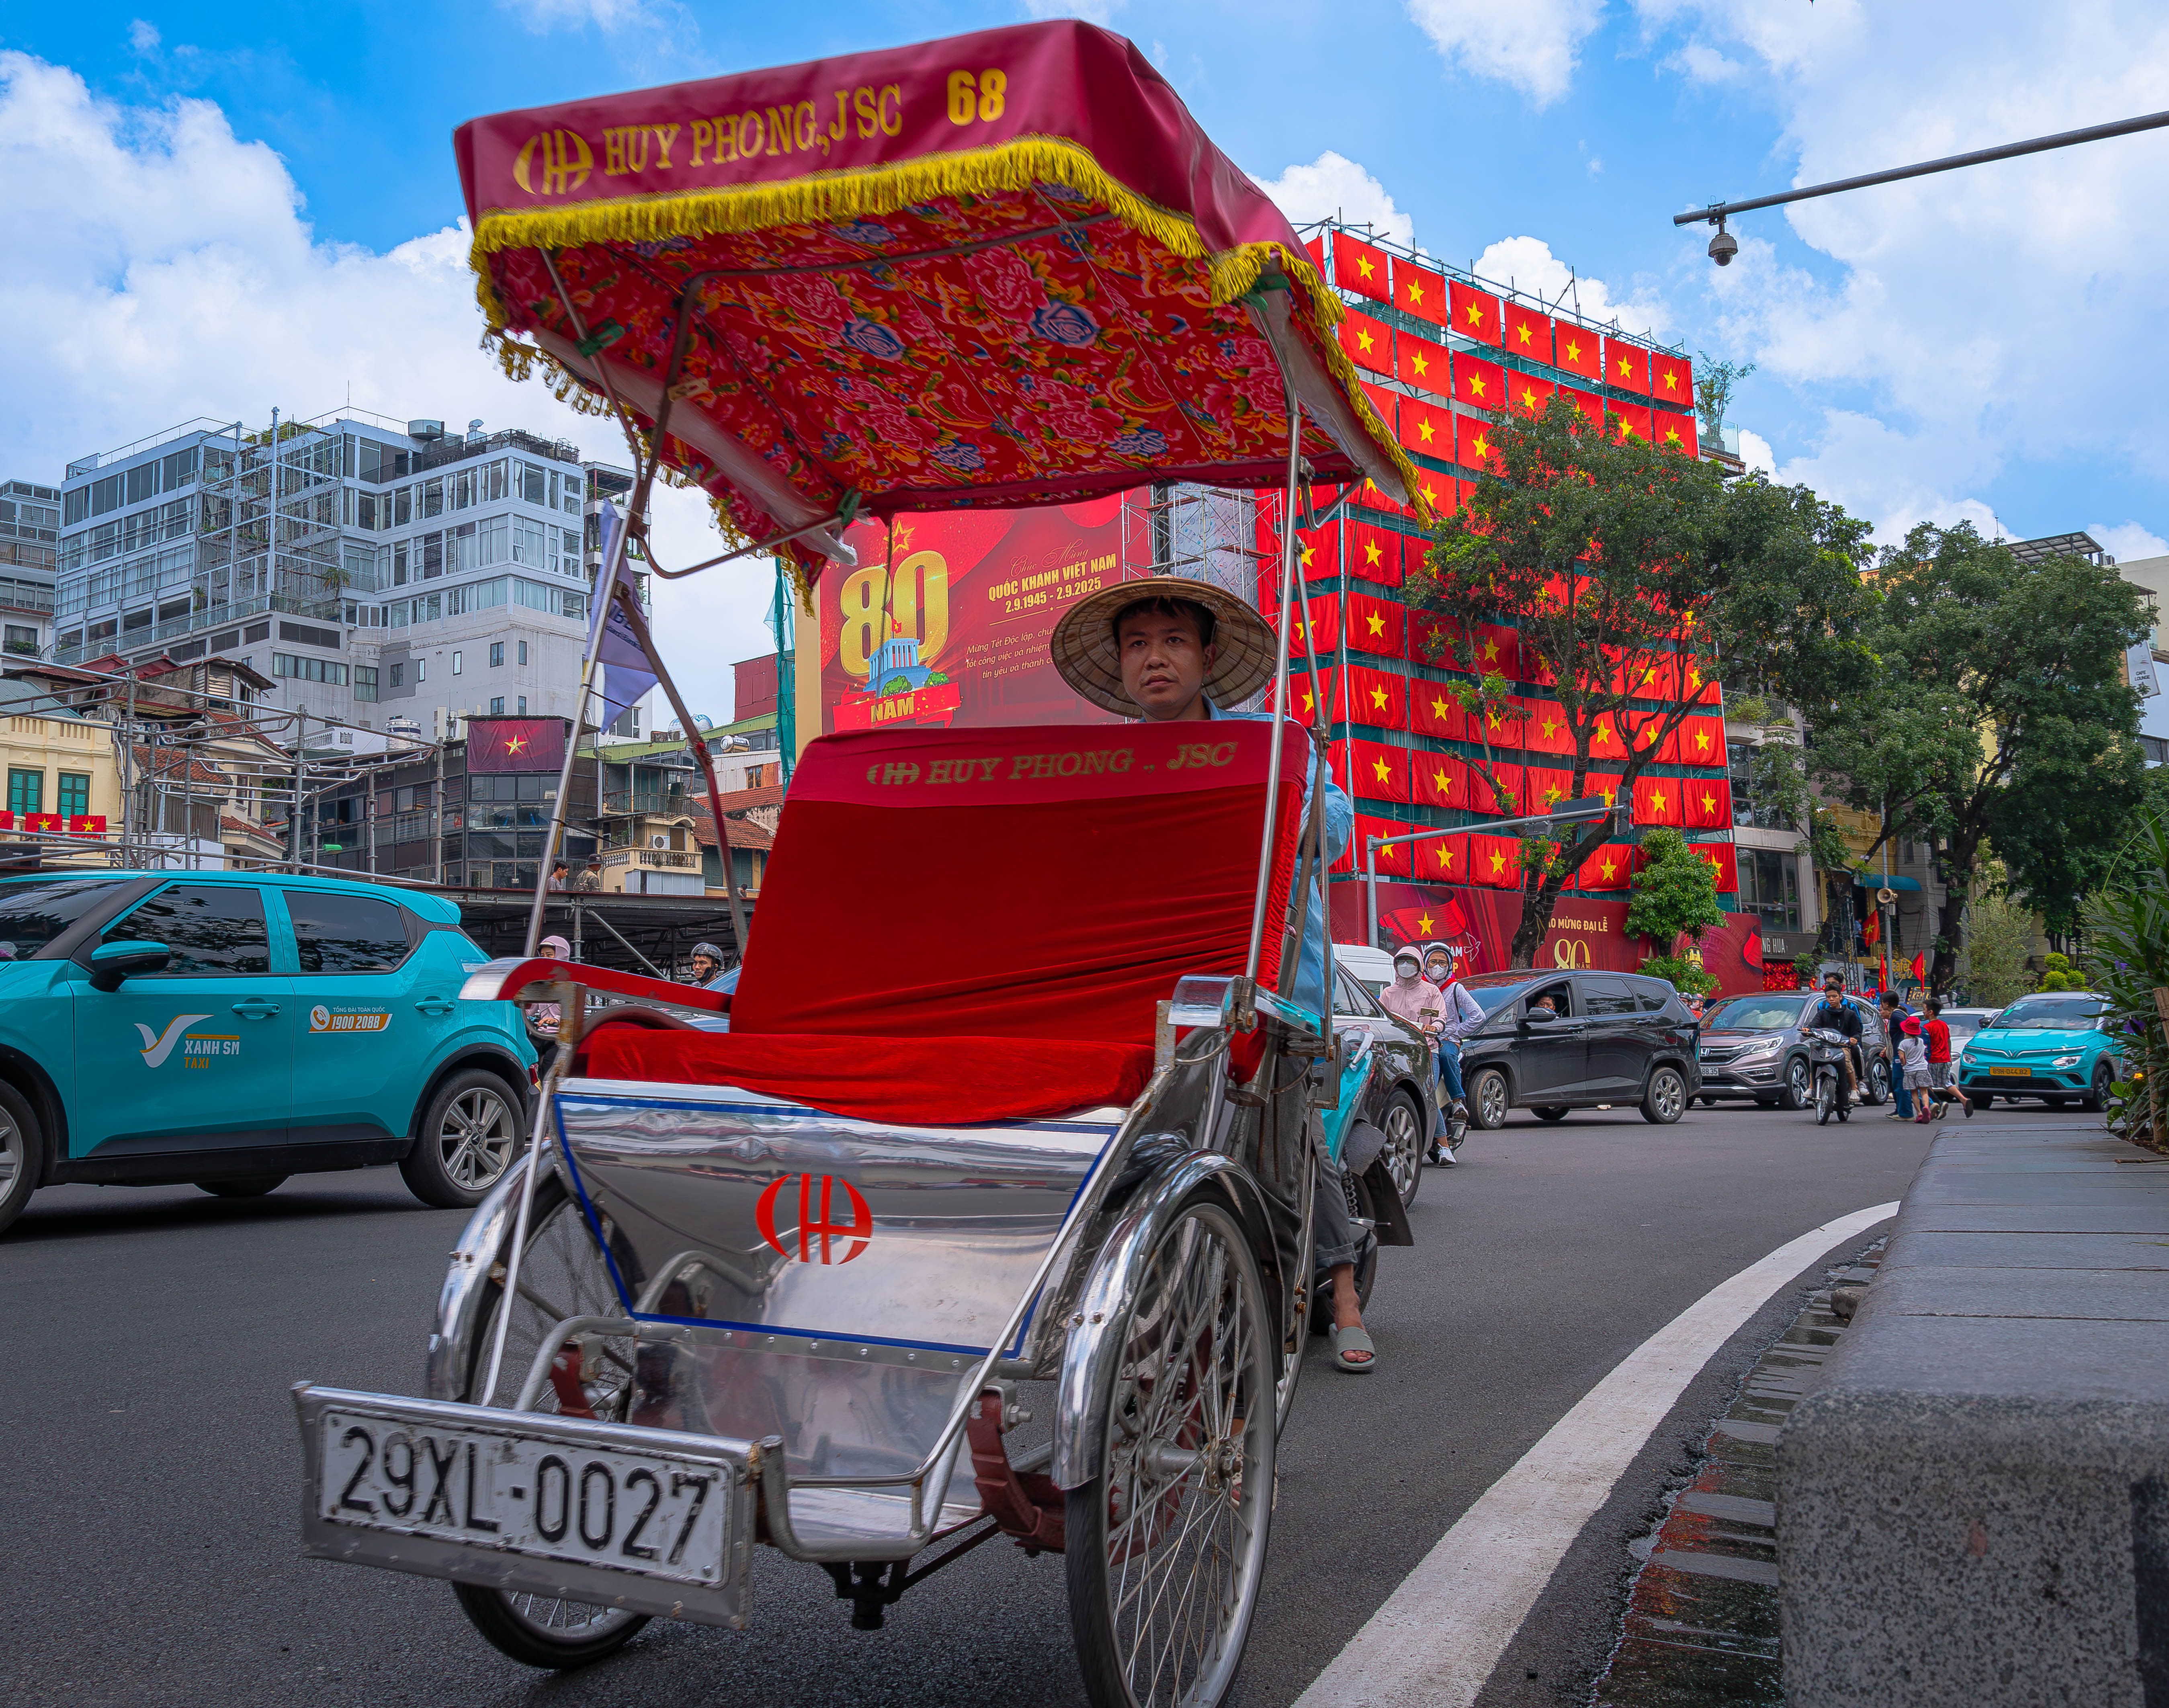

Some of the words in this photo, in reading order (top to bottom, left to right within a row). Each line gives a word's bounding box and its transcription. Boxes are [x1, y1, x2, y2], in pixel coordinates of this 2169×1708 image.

[602, 123, 682, 176] HUY
[947, 68, 1008, 126] 68
[988, 578, 1018, 602] QUỐC
[1021, 569, 1059, 592] KHÁNH
[1062, 561, 1087, 581] VIỆT
[1090, 553, 1116, 574] NAM
[1005, 591, 1047, 613] 2.9.1945
[1056, 576, 1102, 600] 2.9.2025
[840, 550, 948, 677] 80
[991, 637, 1003, 649] Tết
[1004, 635, 1019, 645] Độc
[978, 656, 996, 667] công
[998, 651, 1012, 661] việc
[1014, 647, 1024, 656] và
[1026, 643, 1050, 655] nhiệm
[982, 670, 992, 679] tin
[994, 666, 1008, 678] yêu
[1010, 663, 1019, 673] và
[1022, 657, 1045, 670] thành
[871, 696, 914, 723] NĂM
[925, 757, 1004, 784] HUY
[1007, 748, 1135, 780] PHONG
[1167, 741, 1239, 770] JSC
[1558, 915, 1582, 930] MỪNG
[1583, 920, 1597, 934] ĐẠI
[1598, 916, 1608, 932] LỄ
[1772, 938, 1786, 953] HUA
[331, 1016, 354, 1030] 1900
[355, 1016, 380, 1029] 2088
[184, 1040, 220, 1054] XANH
[223, 1041, 240, 1055] SM
[184, 1057, 209, 1069] TAXI
